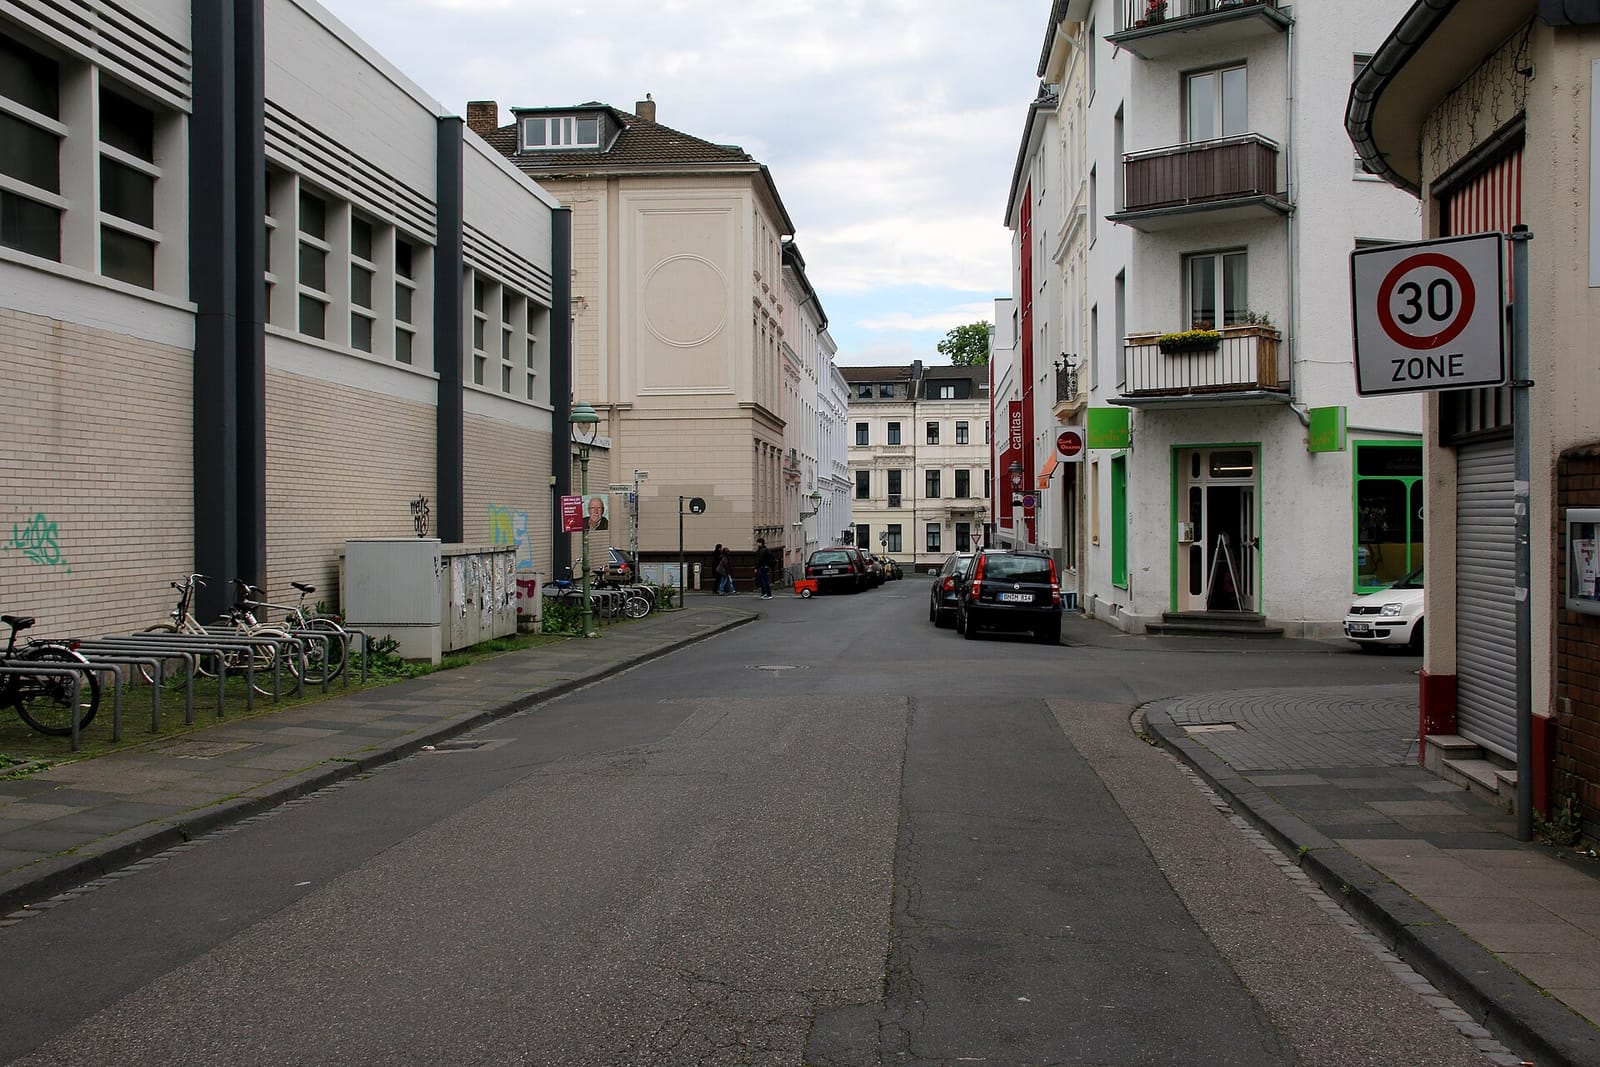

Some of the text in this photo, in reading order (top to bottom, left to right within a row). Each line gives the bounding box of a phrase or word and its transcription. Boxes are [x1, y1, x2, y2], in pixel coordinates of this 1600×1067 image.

[1397, 278, 1453, 324] 30
[1391, 353, 1464, 382] ZONE
[1010, 411, 1022, 450] caritas
